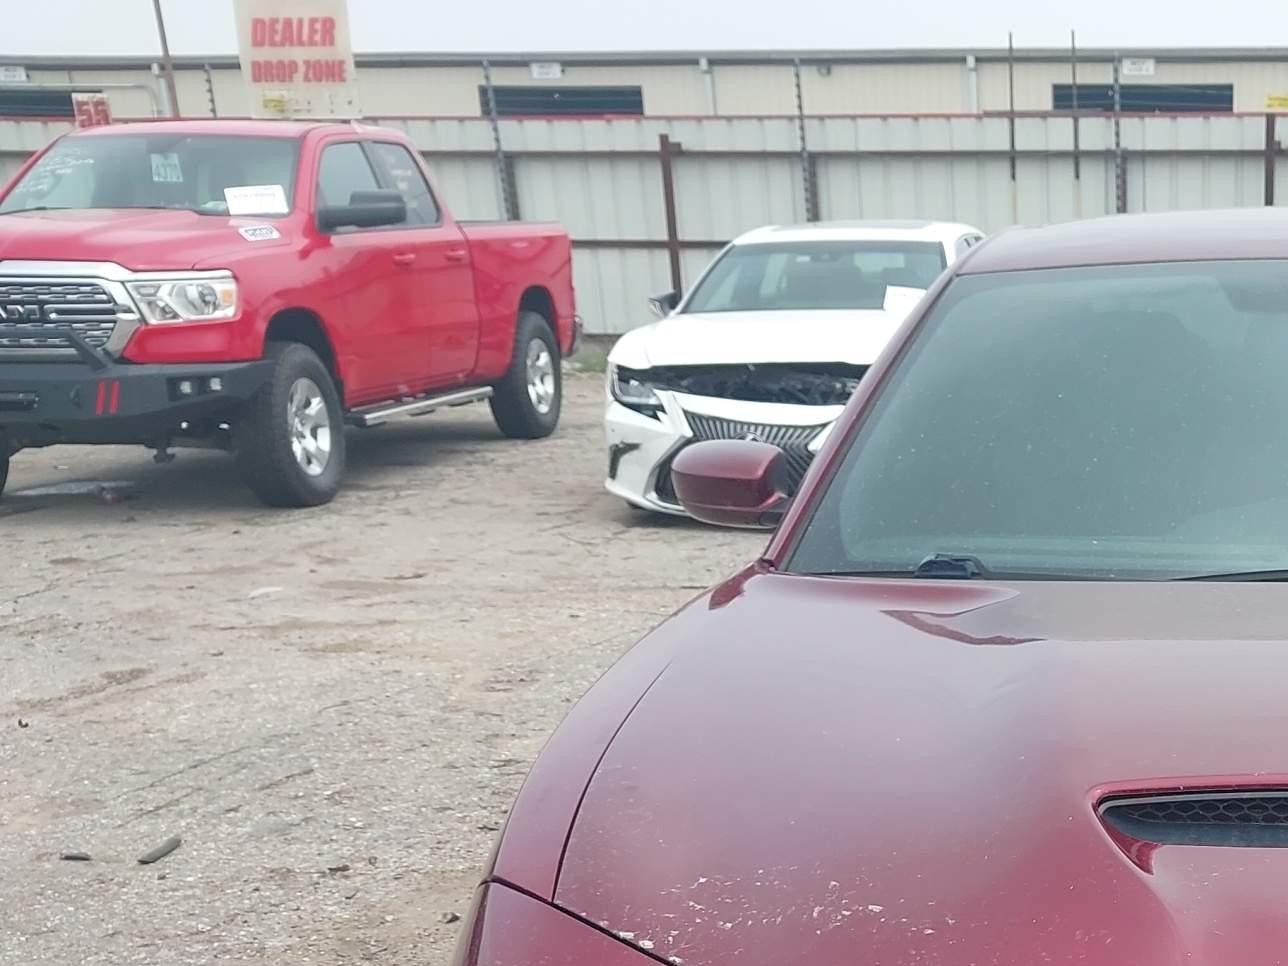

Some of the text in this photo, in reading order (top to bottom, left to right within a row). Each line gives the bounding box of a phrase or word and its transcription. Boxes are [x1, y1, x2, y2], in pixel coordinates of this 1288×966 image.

[251, 17, 335, 47] DEALER
[251, 59, 347, 83] DROP ZONE
